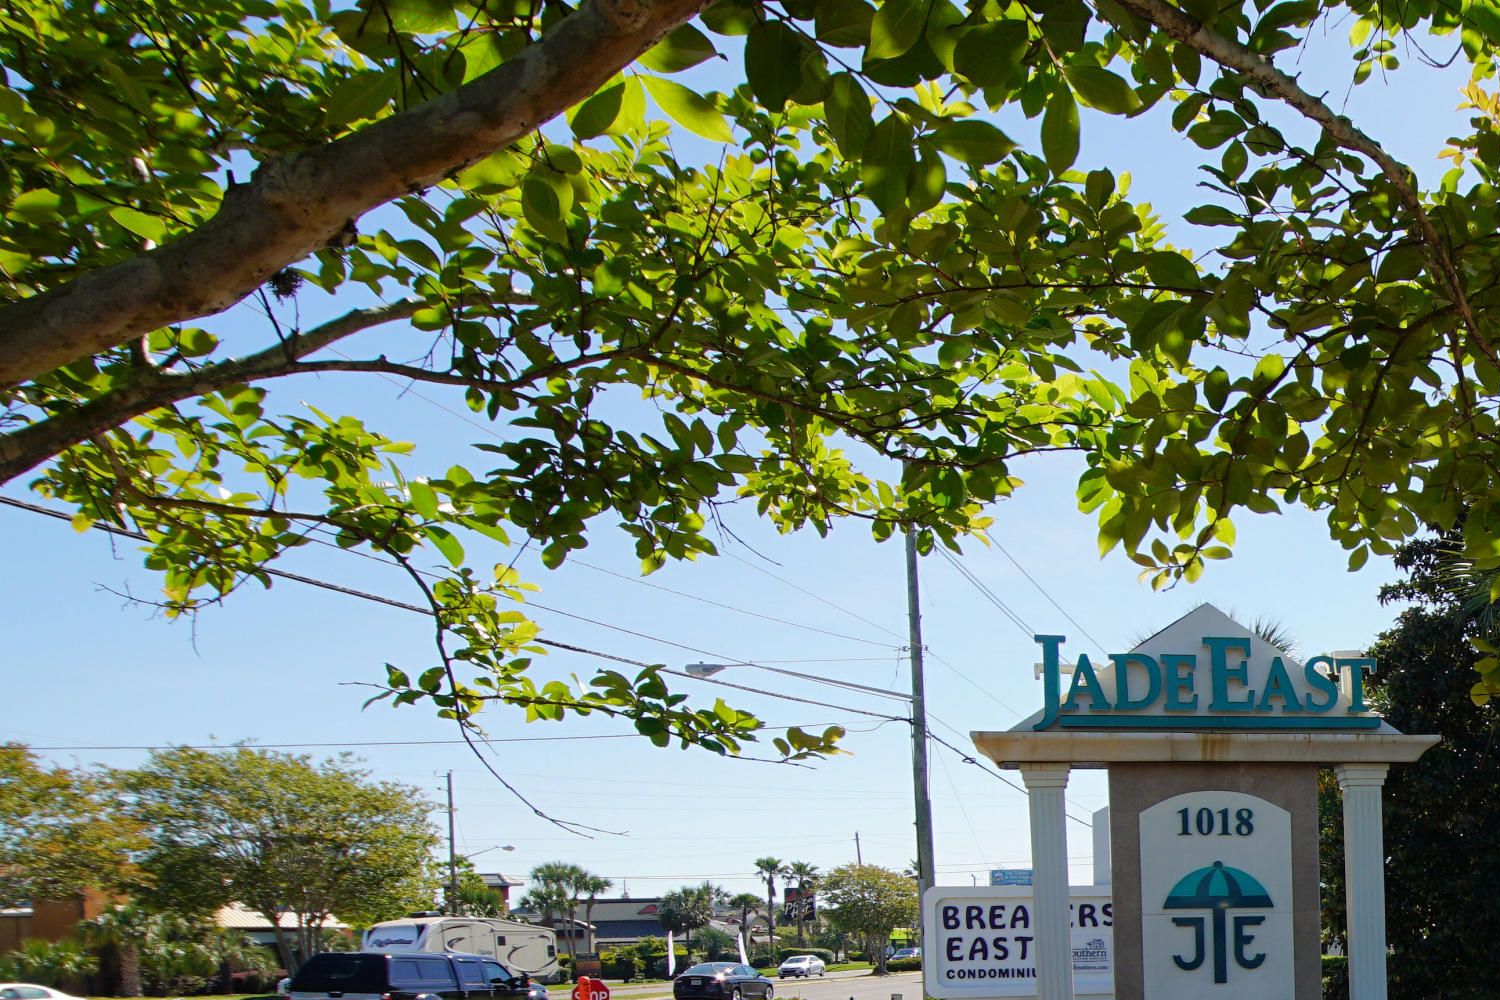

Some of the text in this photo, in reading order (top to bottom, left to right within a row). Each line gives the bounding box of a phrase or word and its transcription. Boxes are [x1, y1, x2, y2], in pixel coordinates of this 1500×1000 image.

[1177, 807, 1254, 836] 1018
[943, 904, 1113, 930] BREARS
[946, 936, 1033, 961] EAST
[1072, 947, 1107, 957] outhern
[946, 968, 1037, 979] CONDOMINIU
